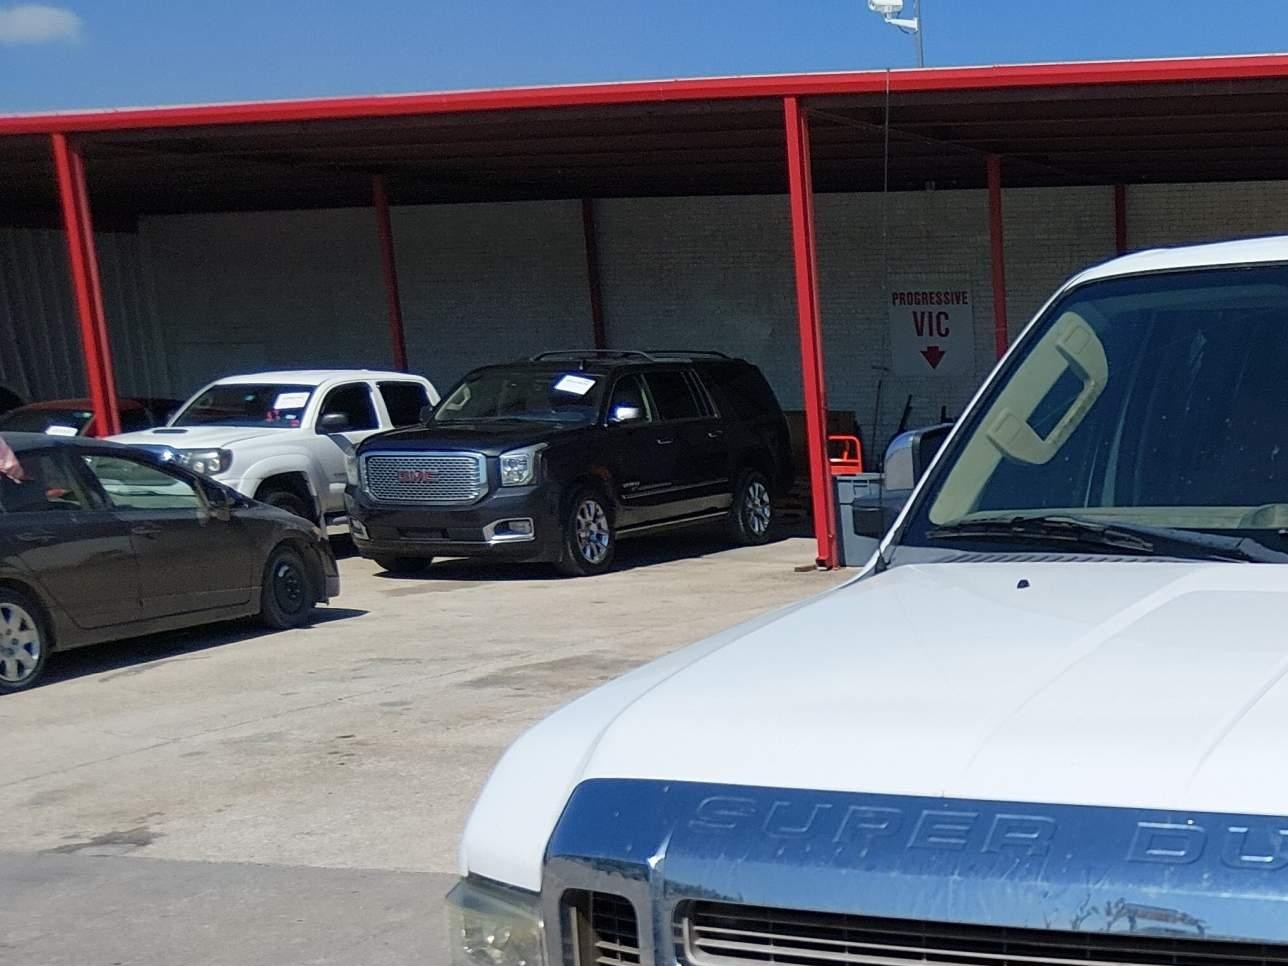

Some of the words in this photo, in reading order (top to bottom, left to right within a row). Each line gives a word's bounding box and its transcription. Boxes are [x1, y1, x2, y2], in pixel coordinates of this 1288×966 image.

[892, 291, 969, 306] PROGRESSIVE
[912, 311, 951, 337] VIC
[688, 794, 1058, 857] SUPER
